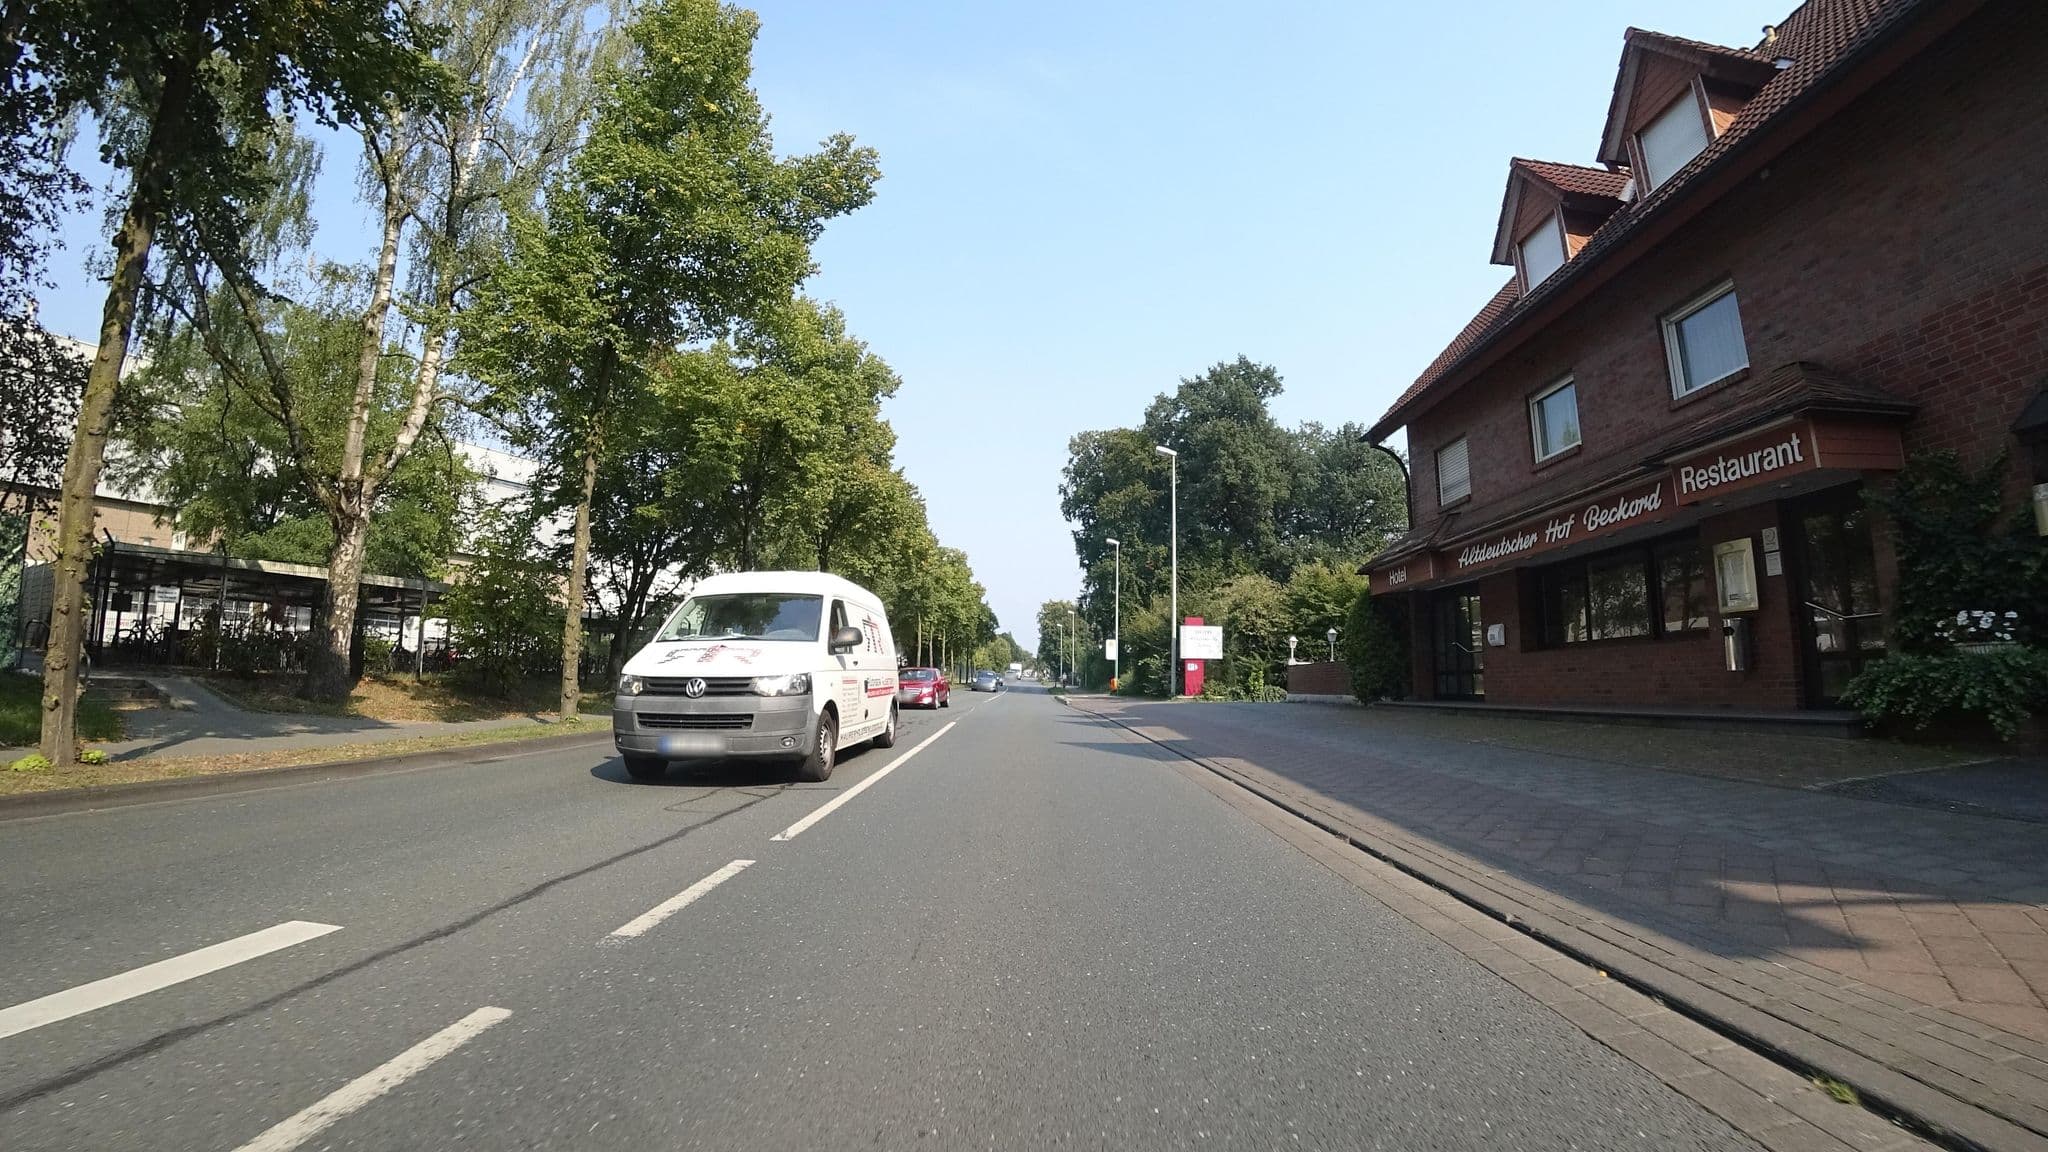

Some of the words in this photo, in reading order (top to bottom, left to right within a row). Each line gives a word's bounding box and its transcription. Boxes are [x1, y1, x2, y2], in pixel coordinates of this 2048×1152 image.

[1681, 433, 1803, 494] Restaurant
[1458, 531, 1538, 568] Altdeutscher
[1545, 514, 1575, 543] Hof
[1583, 483, 1662, 532] Beckord
[1389, 565, 1407, 586] Hotel
